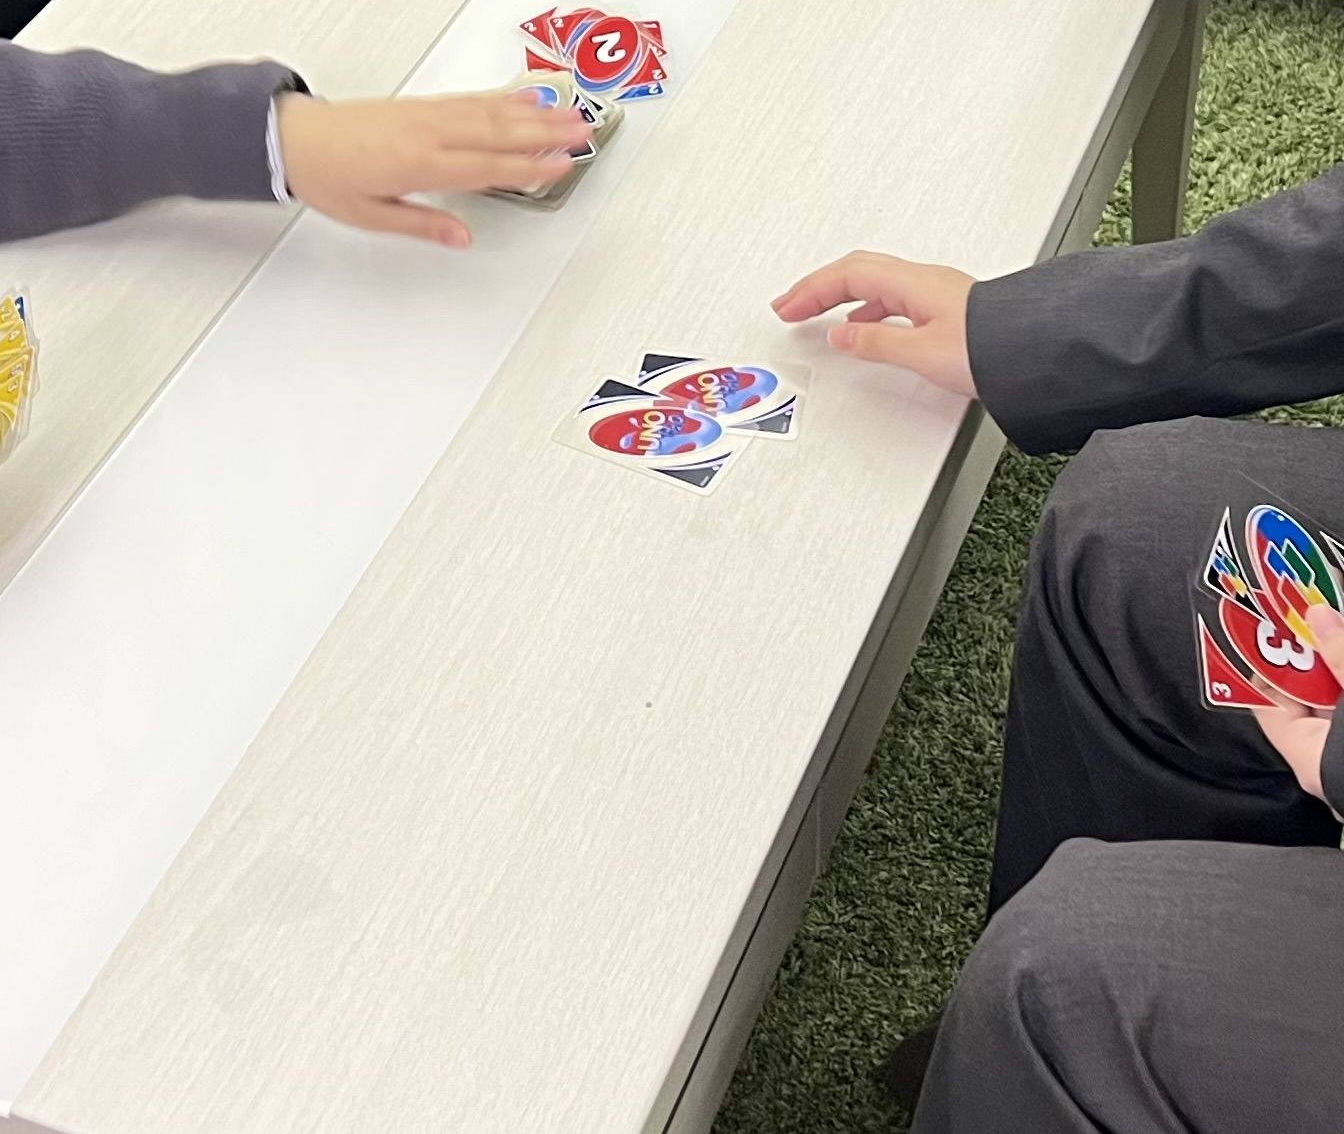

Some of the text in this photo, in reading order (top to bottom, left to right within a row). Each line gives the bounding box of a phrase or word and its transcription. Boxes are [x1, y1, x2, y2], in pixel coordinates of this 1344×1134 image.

[552, 18, 564, 28] 2
[590, 31, 626, 64] 2
[651, 69, 663, 80] 2
[697, 373, 728, 412] UNO
[637, 410, 667, 451] UNO
[1256, 621, 1316, 671] 3
[1211, 681, 1232, 698] 3
